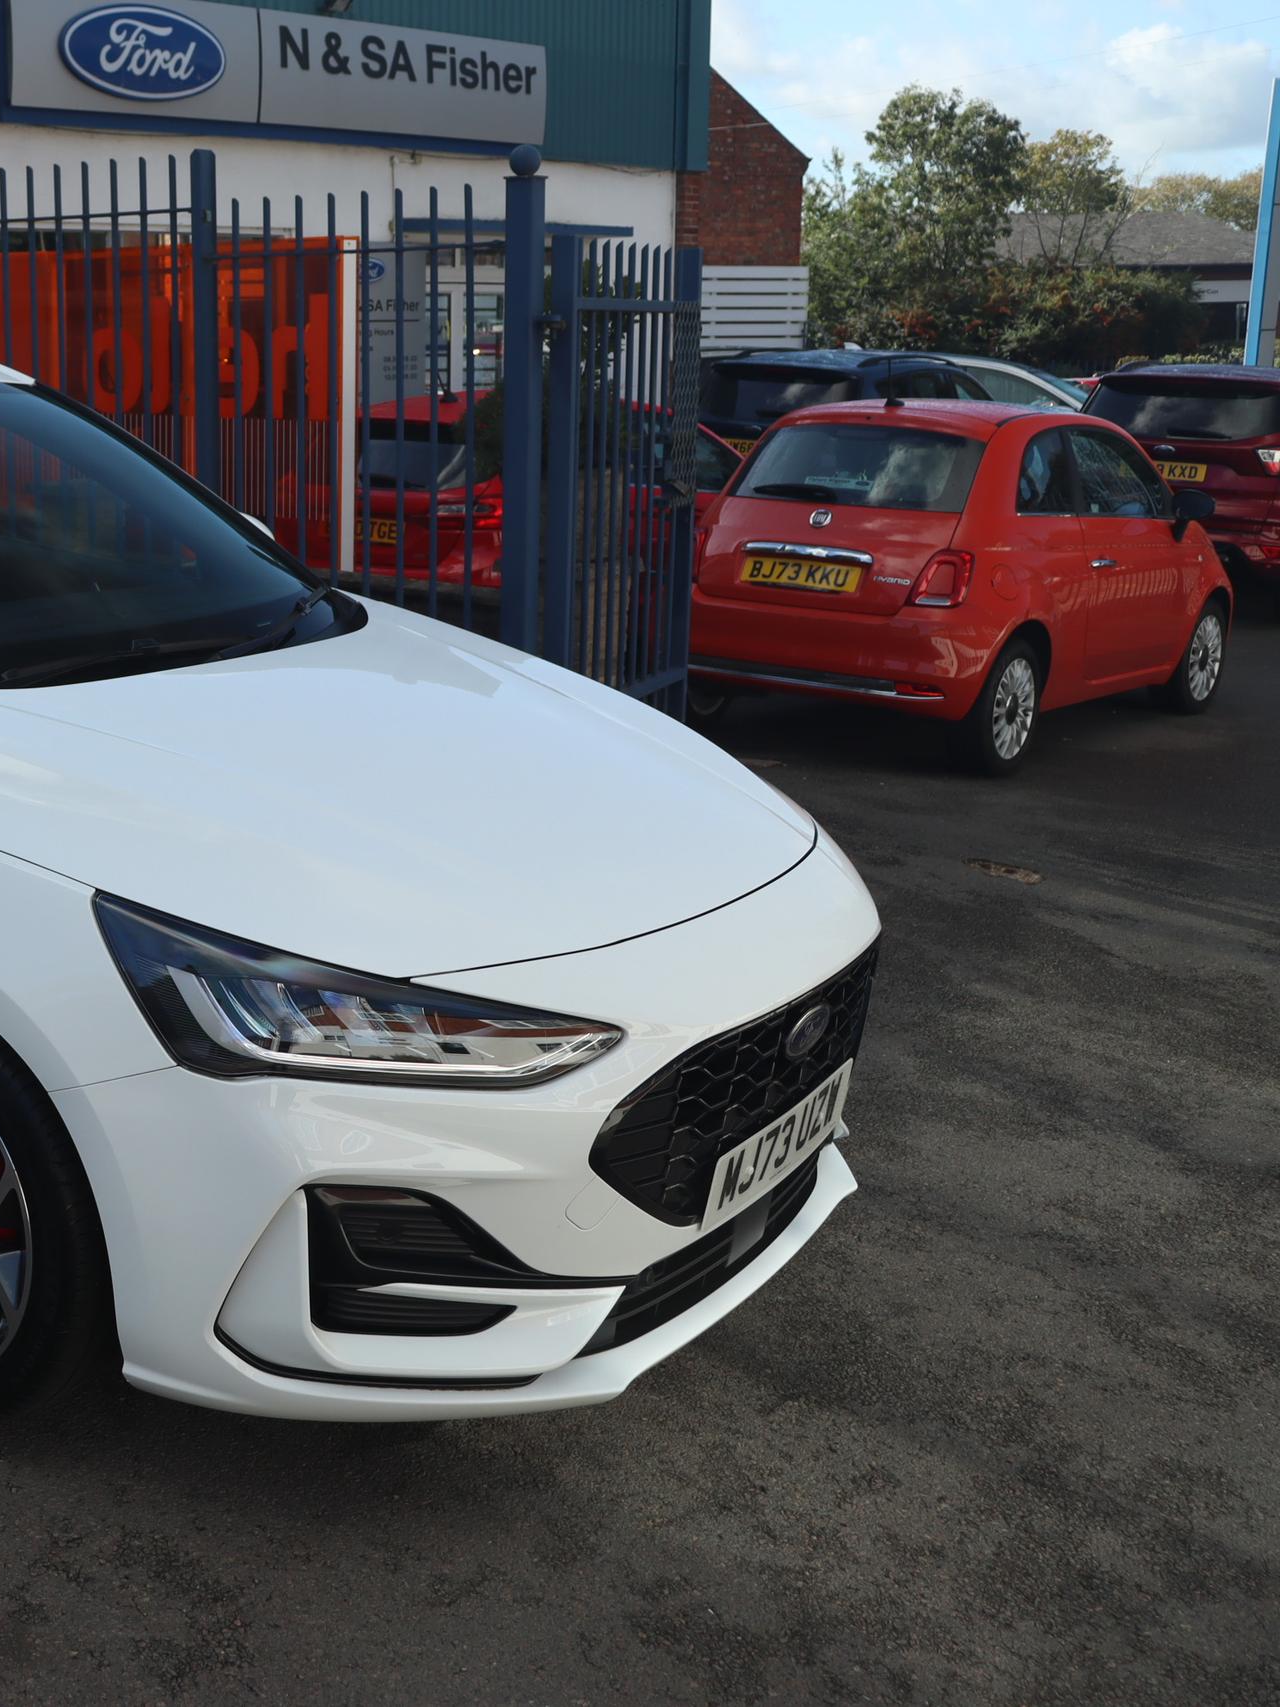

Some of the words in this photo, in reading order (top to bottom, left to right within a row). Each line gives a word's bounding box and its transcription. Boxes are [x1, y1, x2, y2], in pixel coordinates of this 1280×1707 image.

[99, 17, 197, 80] Ford
[278, 25, 310, 70] N
[322, 31, 352, 75] &
[361, 35, 417, 82] SA
[425, 44, 537, 95] Fisher
[1167, 463, 1199, 480] KXD
[749, 560, 803, 580] BJ73
[804, 564, 850, 588] KKU
[717, 1113, 796, 1211] MJ73
